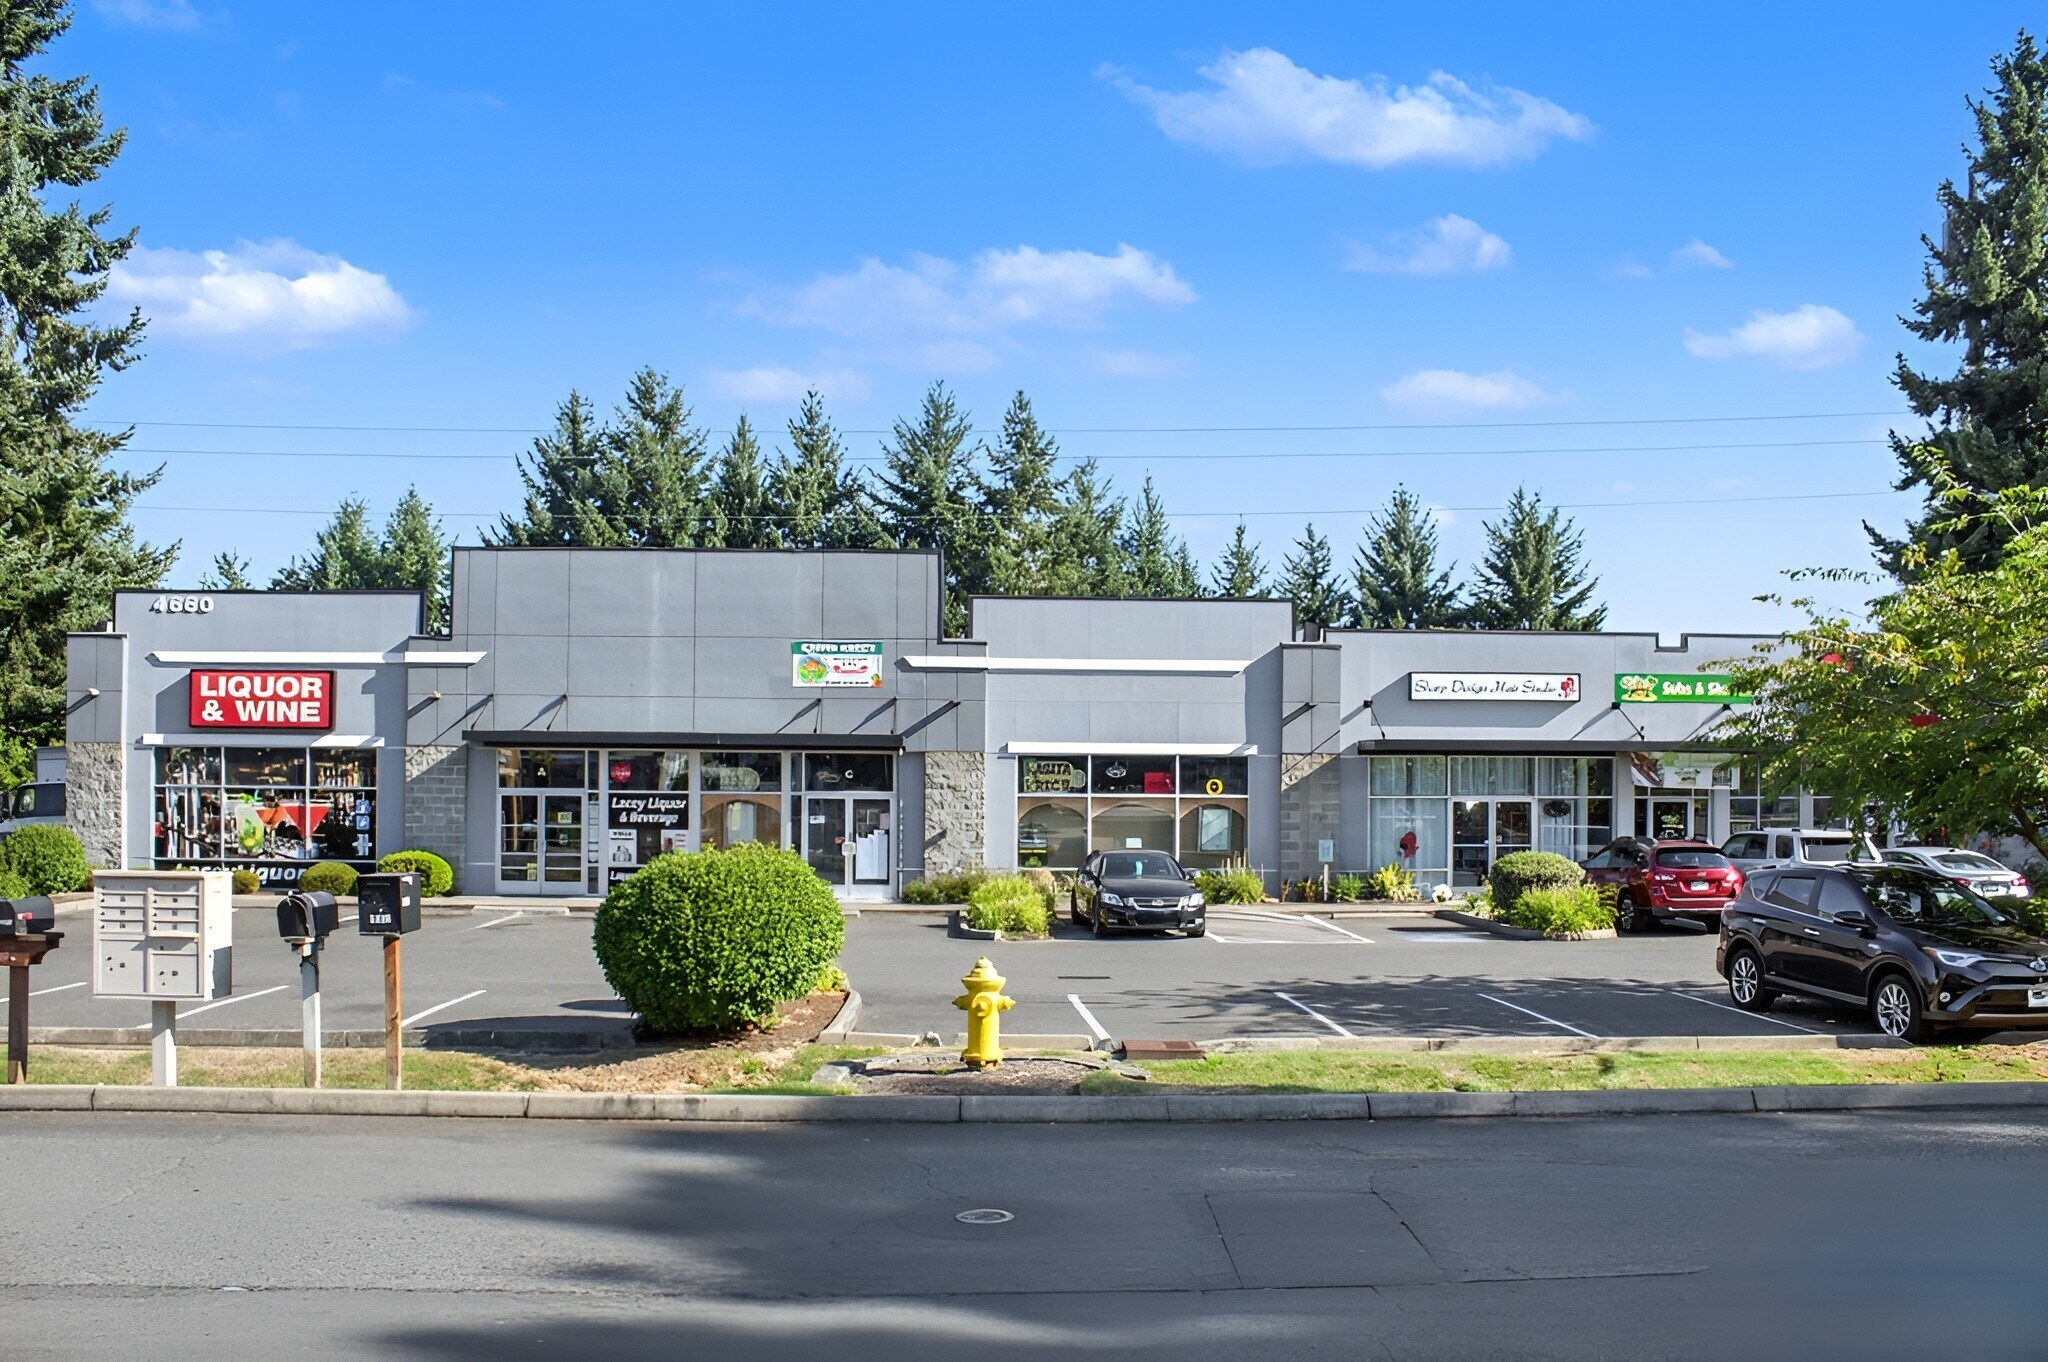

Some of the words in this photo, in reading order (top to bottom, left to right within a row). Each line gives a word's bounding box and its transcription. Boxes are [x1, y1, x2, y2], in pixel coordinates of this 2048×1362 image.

[200, 675, 323, 698] LIQUOR
[1451, 679, 1488, 695] Design
[1521, 679, 1557, 693] Studio
[1662, 681, 1692, 695] Subs
[201, 699, 224, 721] &
[234, 700, 320, 722] WINE
[845, 769, 854, 779] C
[611, 797, 646, 812] Lacey
[647, 797, 687, 812] Liquor
[629, 811, 678, 827] Beverage
